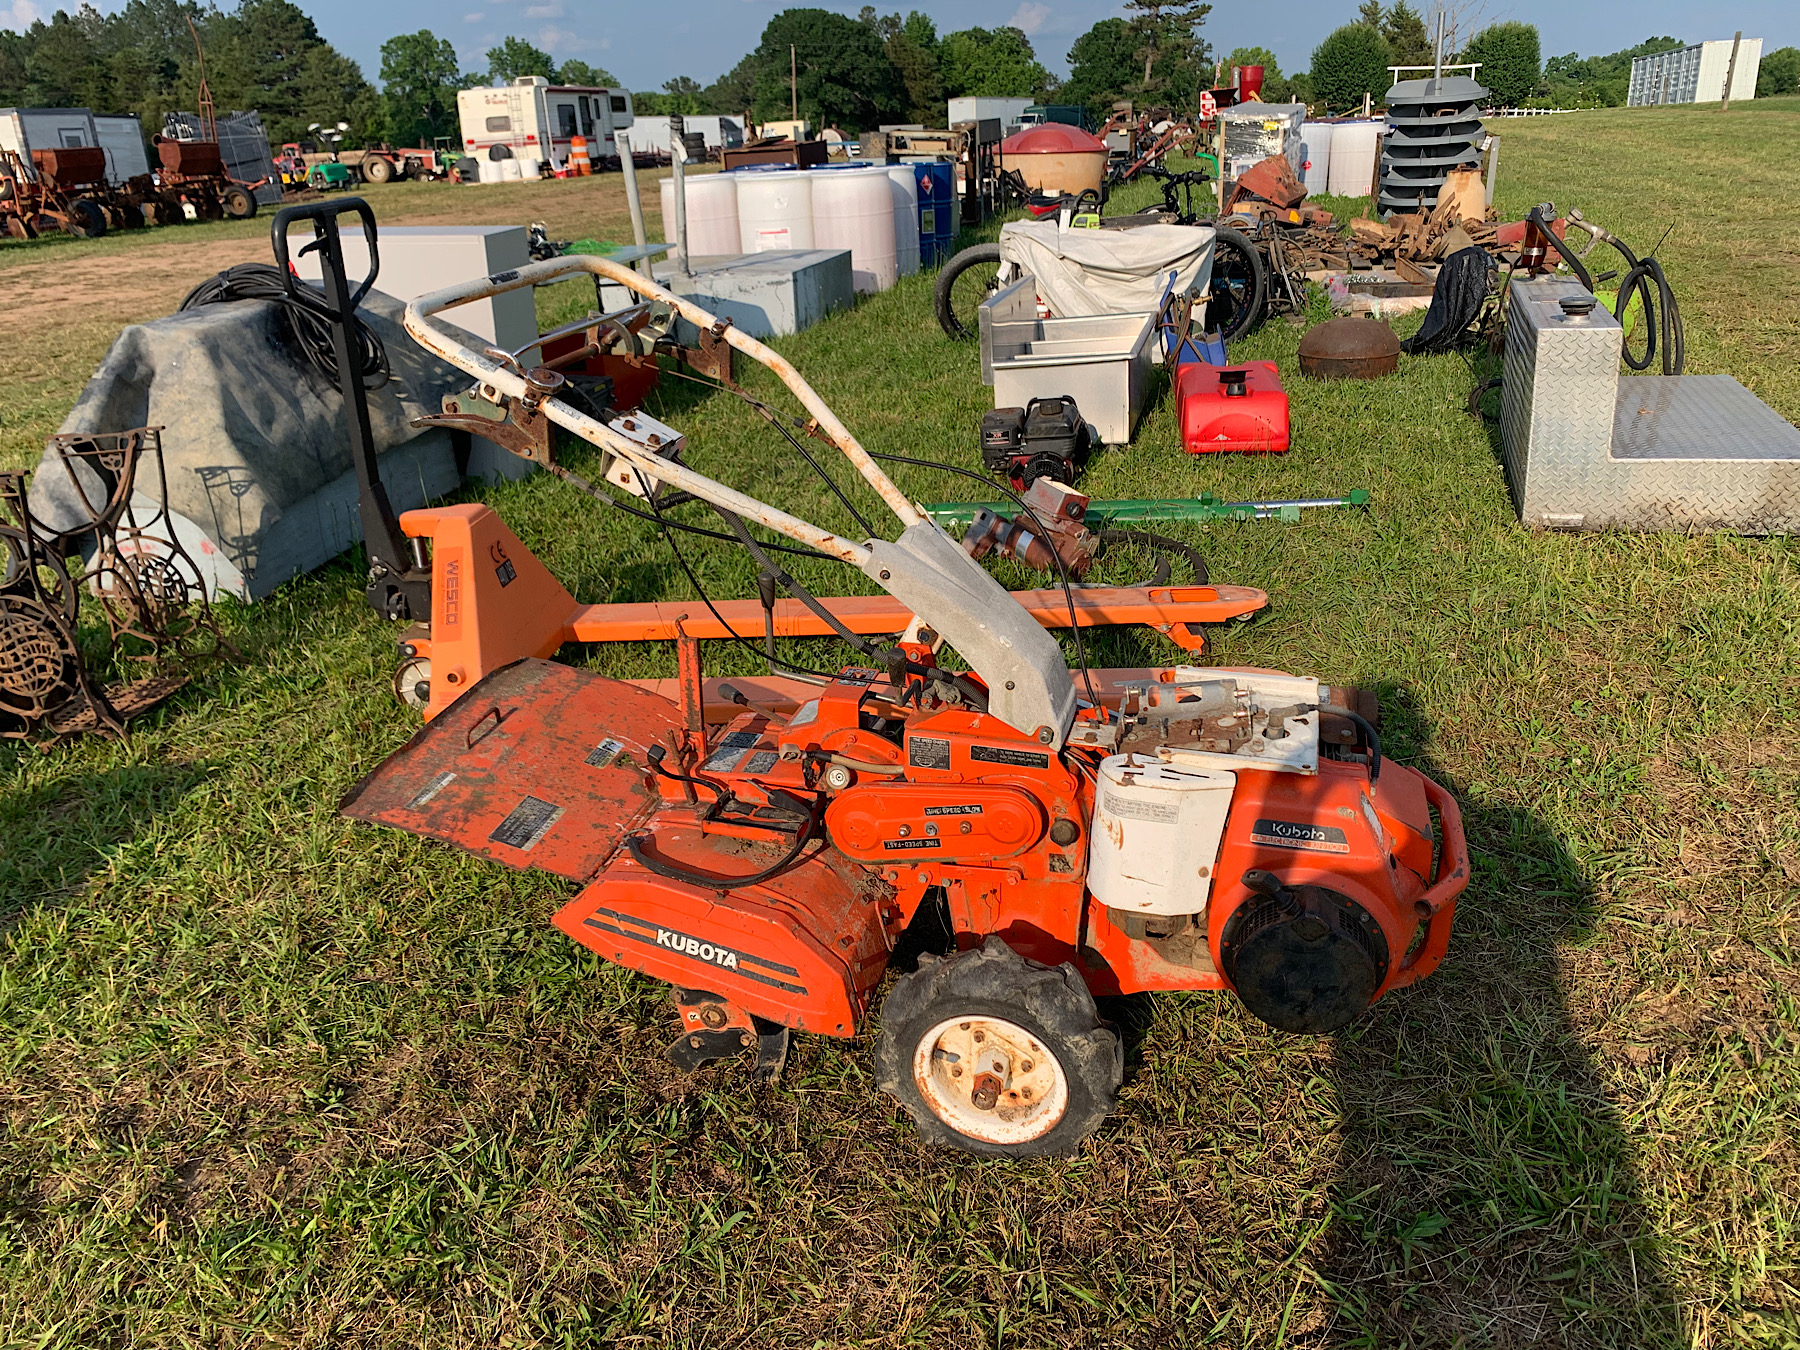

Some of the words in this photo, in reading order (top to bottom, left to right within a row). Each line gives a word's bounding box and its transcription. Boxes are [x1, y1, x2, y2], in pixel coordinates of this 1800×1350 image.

[445, 559, 459, 625] WESCO
[1266, 836, 1307, 848] ELECTRONIC
[1310, 842, 1344, 851] IGNITION
[1272, 823, 1326, 841] Kubota
[656, 929, 738, 970] KUBOTA
